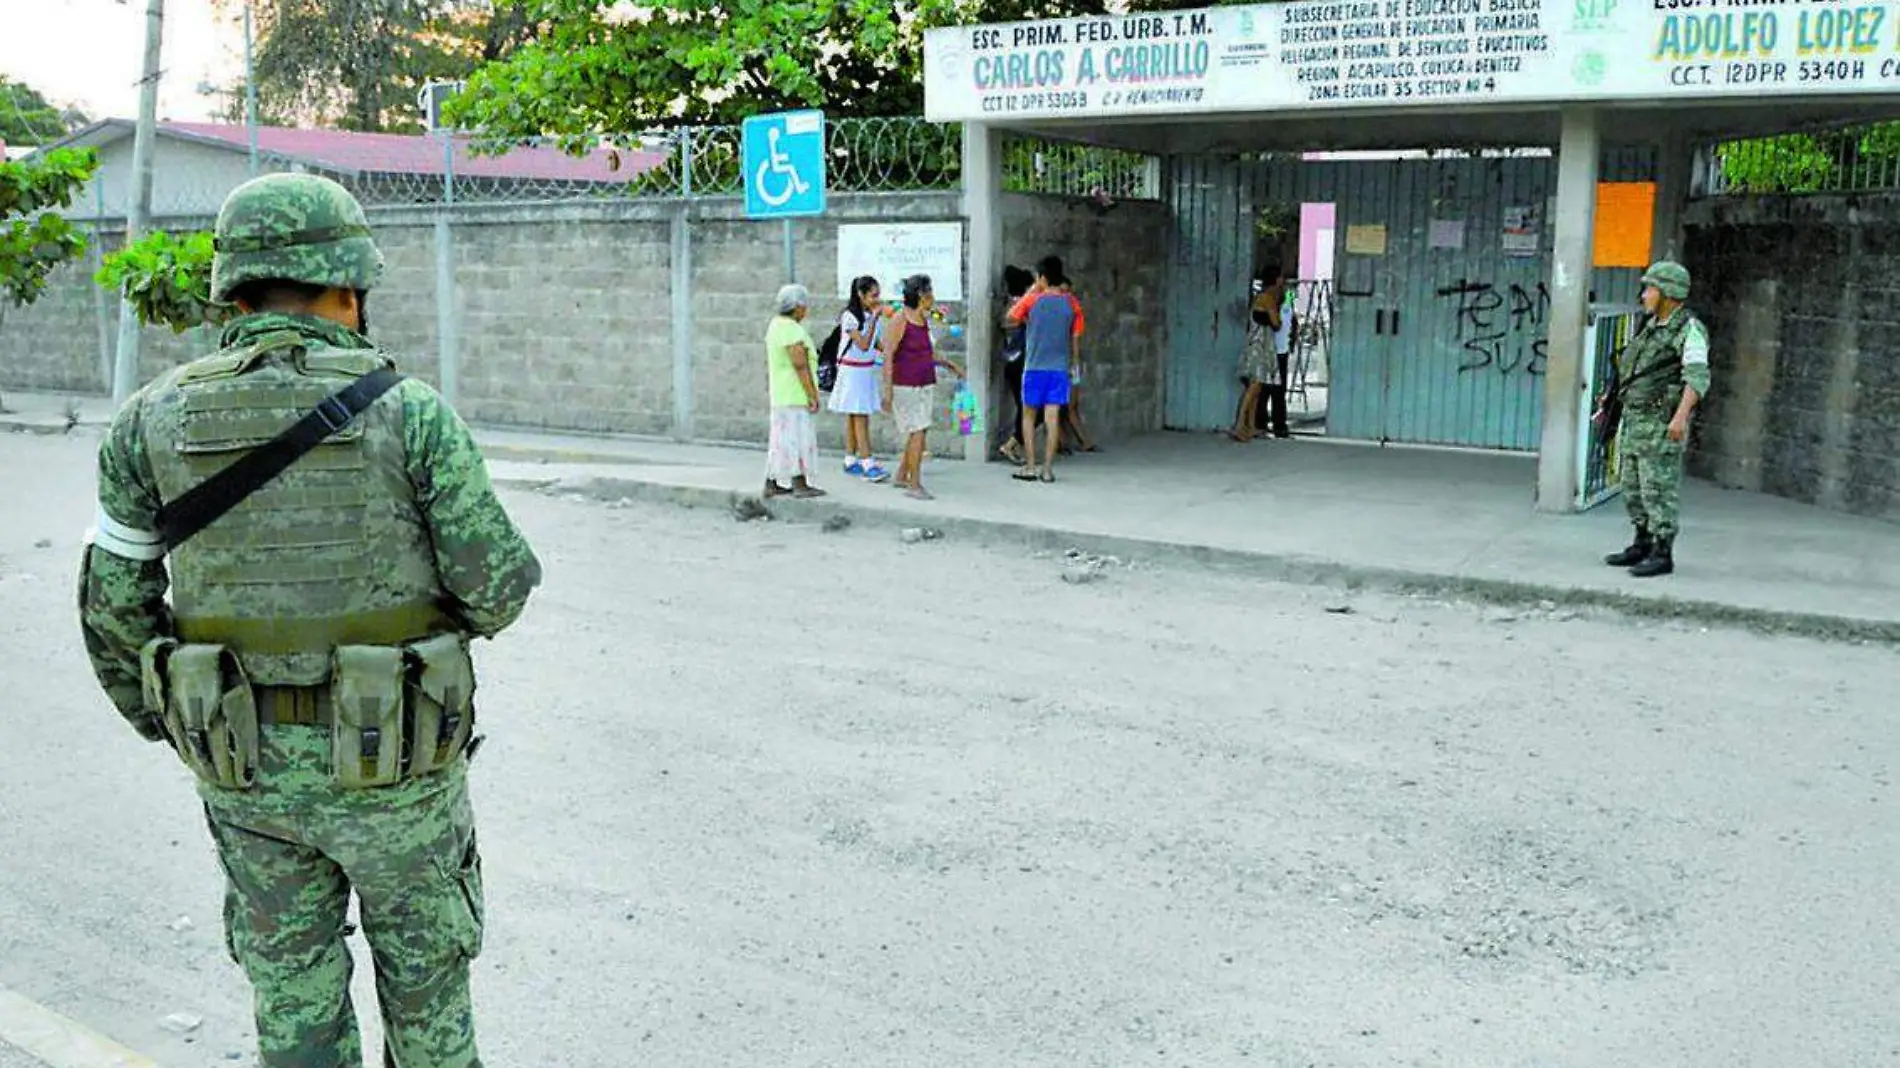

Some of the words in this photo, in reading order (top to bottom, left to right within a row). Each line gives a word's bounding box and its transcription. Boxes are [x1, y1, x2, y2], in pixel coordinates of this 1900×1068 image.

[1281, 25, 1337, 44] DIRECCION
[1475, 12, 1540, 31] PRIMARIA
[1284, 3, 1379, 24] SUBSECRETARIA
[1386, 1, 1400, 18] DE
[1405, 0, 1481, 17] EDUCACION
[972, 30, 1004, 50] ESC.
[1014, 24, 1068, 47] PRIM.
[1076, 21, 1118, 43] FED.
[1123, 17, 1169, 39] URB.
[1654, 10, 1779, 57] ADOLFO
[1796, 6, 1886, 54] LOPEZ
[973, 50, 1065, 89] CARLOS
[1076, 48, 1101, 84] A.
[1104, 41, 1210, 83] CARRILLO
[1726, 61, 1787, 84] 12DPR
[1418, 79, 1460, 96] SECTOR
[1484, 76, 1495, 93] 4
